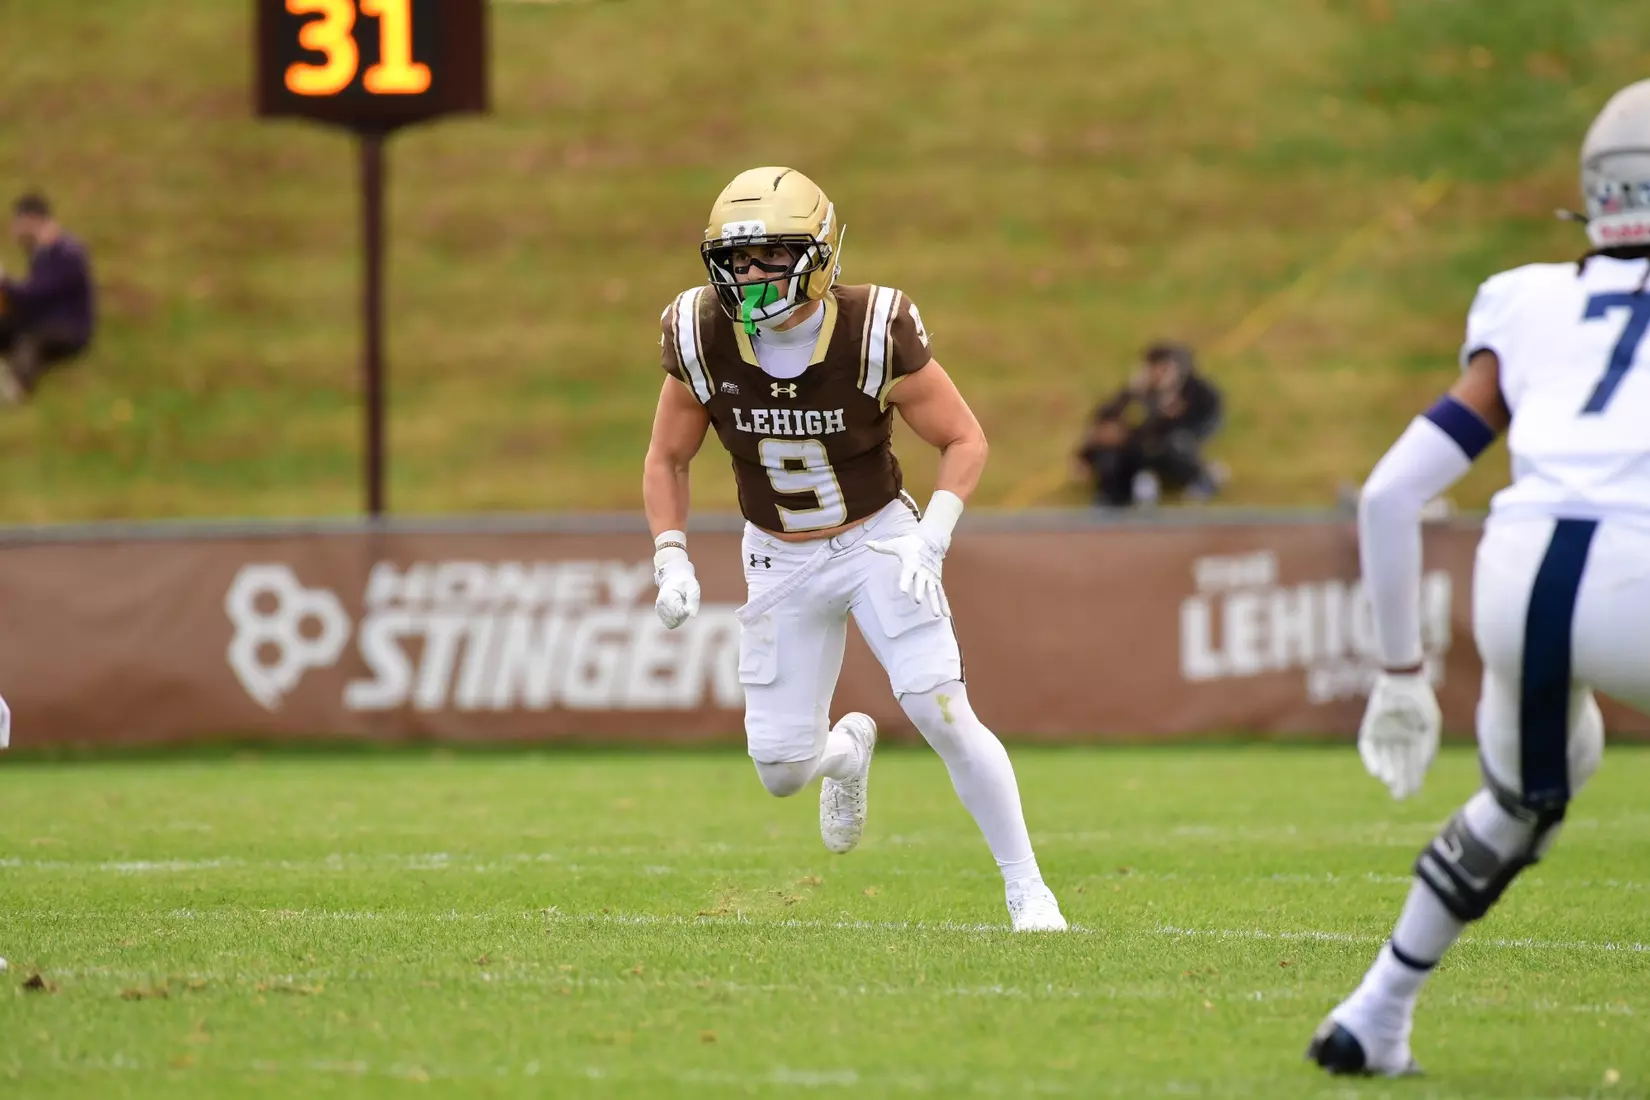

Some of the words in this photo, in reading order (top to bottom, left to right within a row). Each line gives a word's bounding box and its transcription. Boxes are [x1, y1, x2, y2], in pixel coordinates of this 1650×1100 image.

[284, 0, 432, 96] 31
[1578, 291, 1650, 416] 7
[732, 407, 846, 436] LEHIGH
[757, 437, 848, 532] 9
[343, 606, 741, 711] STINGER
